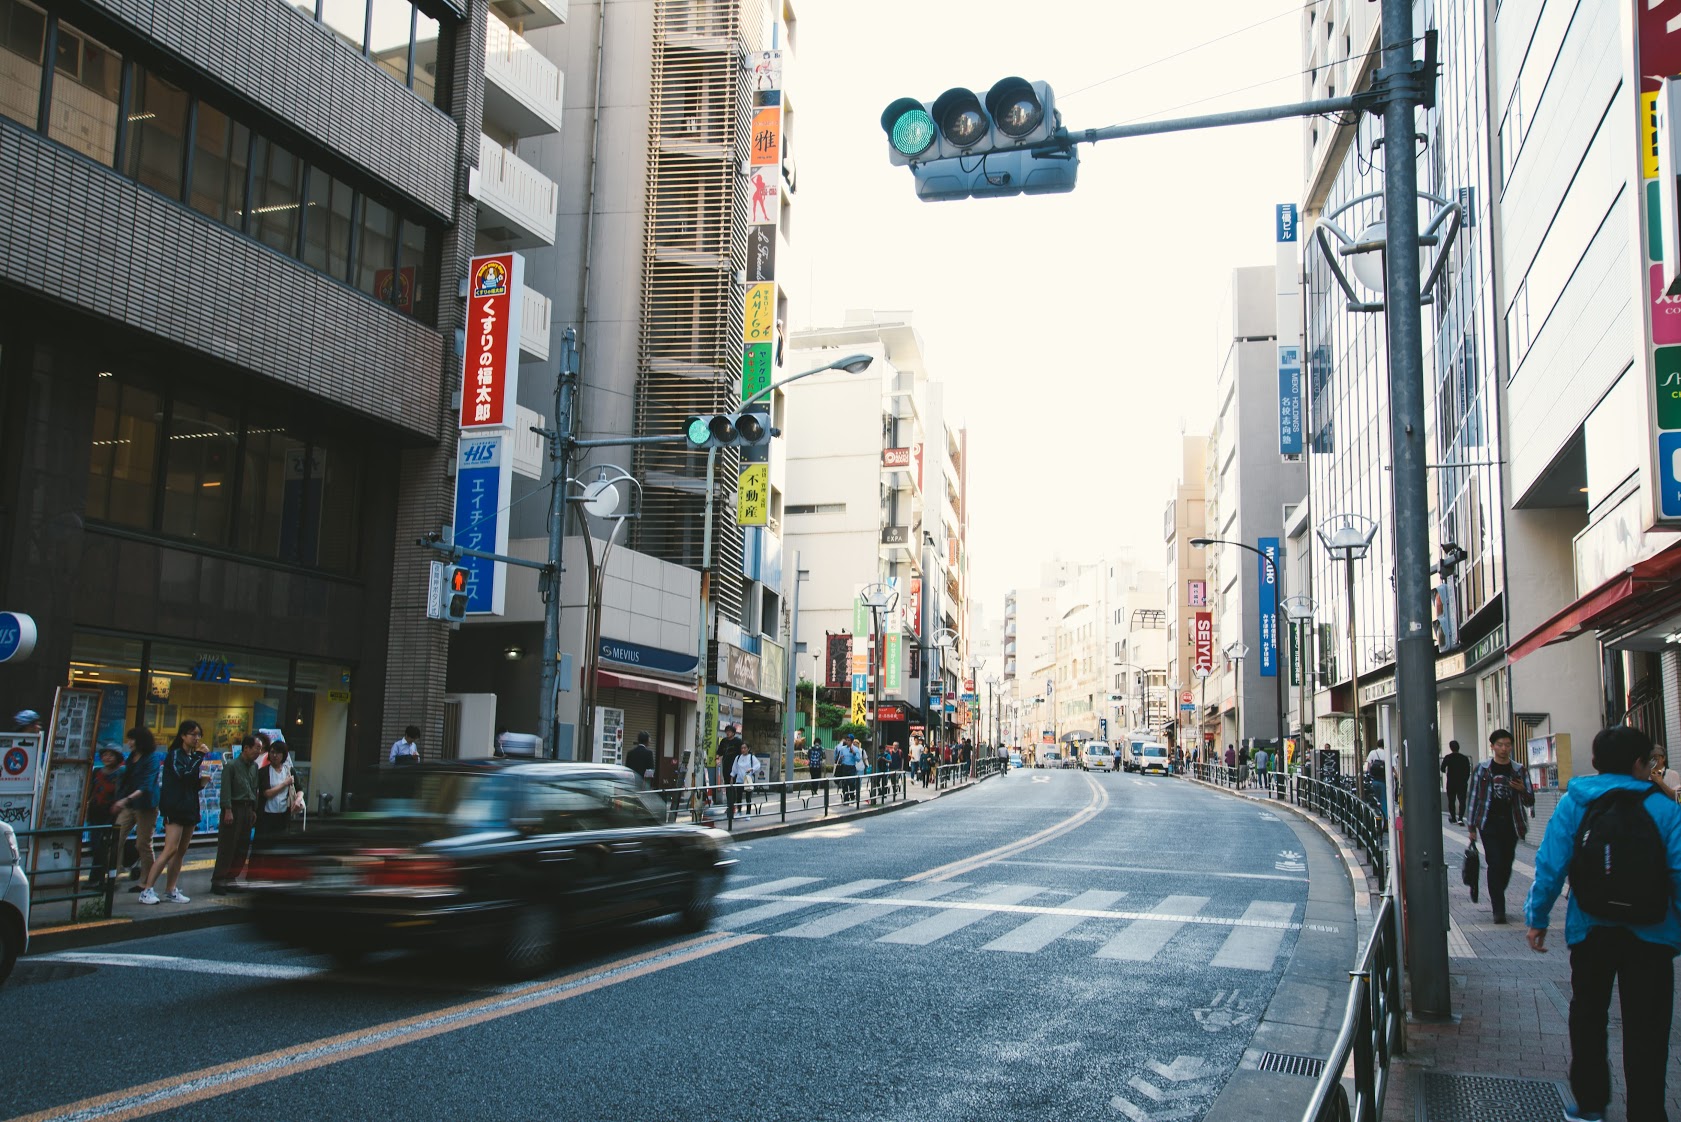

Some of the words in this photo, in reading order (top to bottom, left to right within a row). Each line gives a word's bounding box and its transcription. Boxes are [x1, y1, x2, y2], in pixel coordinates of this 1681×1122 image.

[755, 130, 776, 152] 雅
[751, 290, 761, 338] AMIGO
[475, 298, 495, 422] くすりの福太郎
[758, 351, 766, 391] ヤングロー
[1672, 391, 1681, 399] C
[464, 444, 496, 461] HIS
[745, 473, 759, 518] 不動産
[0, 628, 17, 644] IS
[1197, 619, 1211, 669] SEIYU
[612, 647, 640, 662] MEVIUS
[193, 661, 235, 684] HIS
